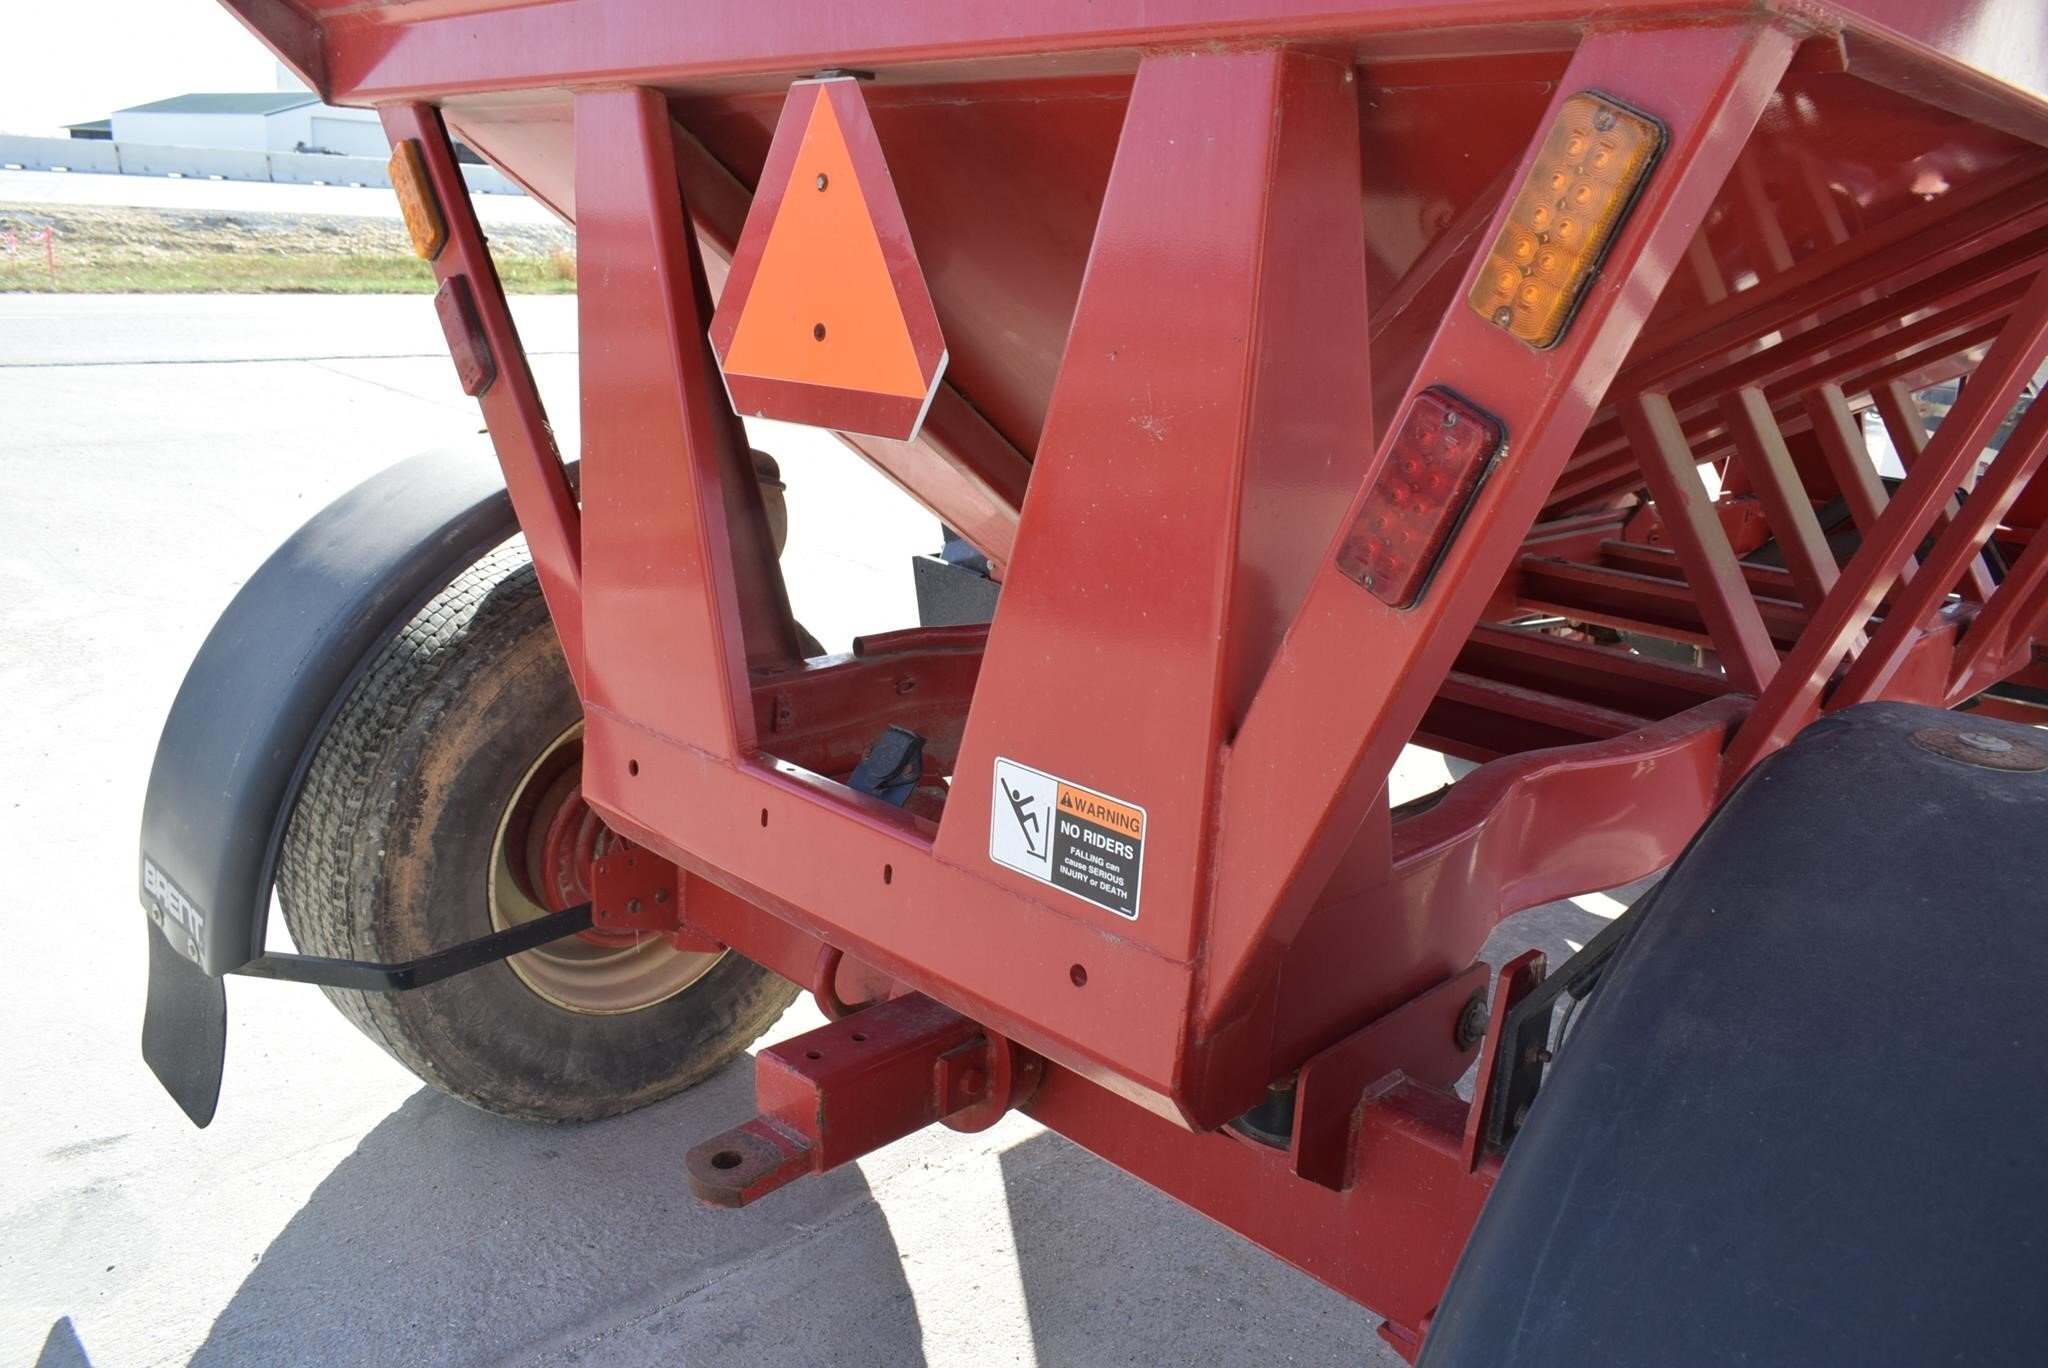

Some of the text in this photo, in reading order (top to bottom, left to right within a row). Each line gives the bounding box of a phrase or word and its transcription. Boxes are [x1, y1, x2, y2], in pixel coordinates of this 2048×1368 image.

[1075, 797, 1140, 833] WARNING
[1061, 821, 1134, 860] NO RIDERS
[1064, 857, 1125, 886] cause SERIOUS
[1070, 847, 1120, 872] FALLING can
[1060, 865, 1128, 899] INJURY or DEATH
[144, 859, 203, 943] BRENT
